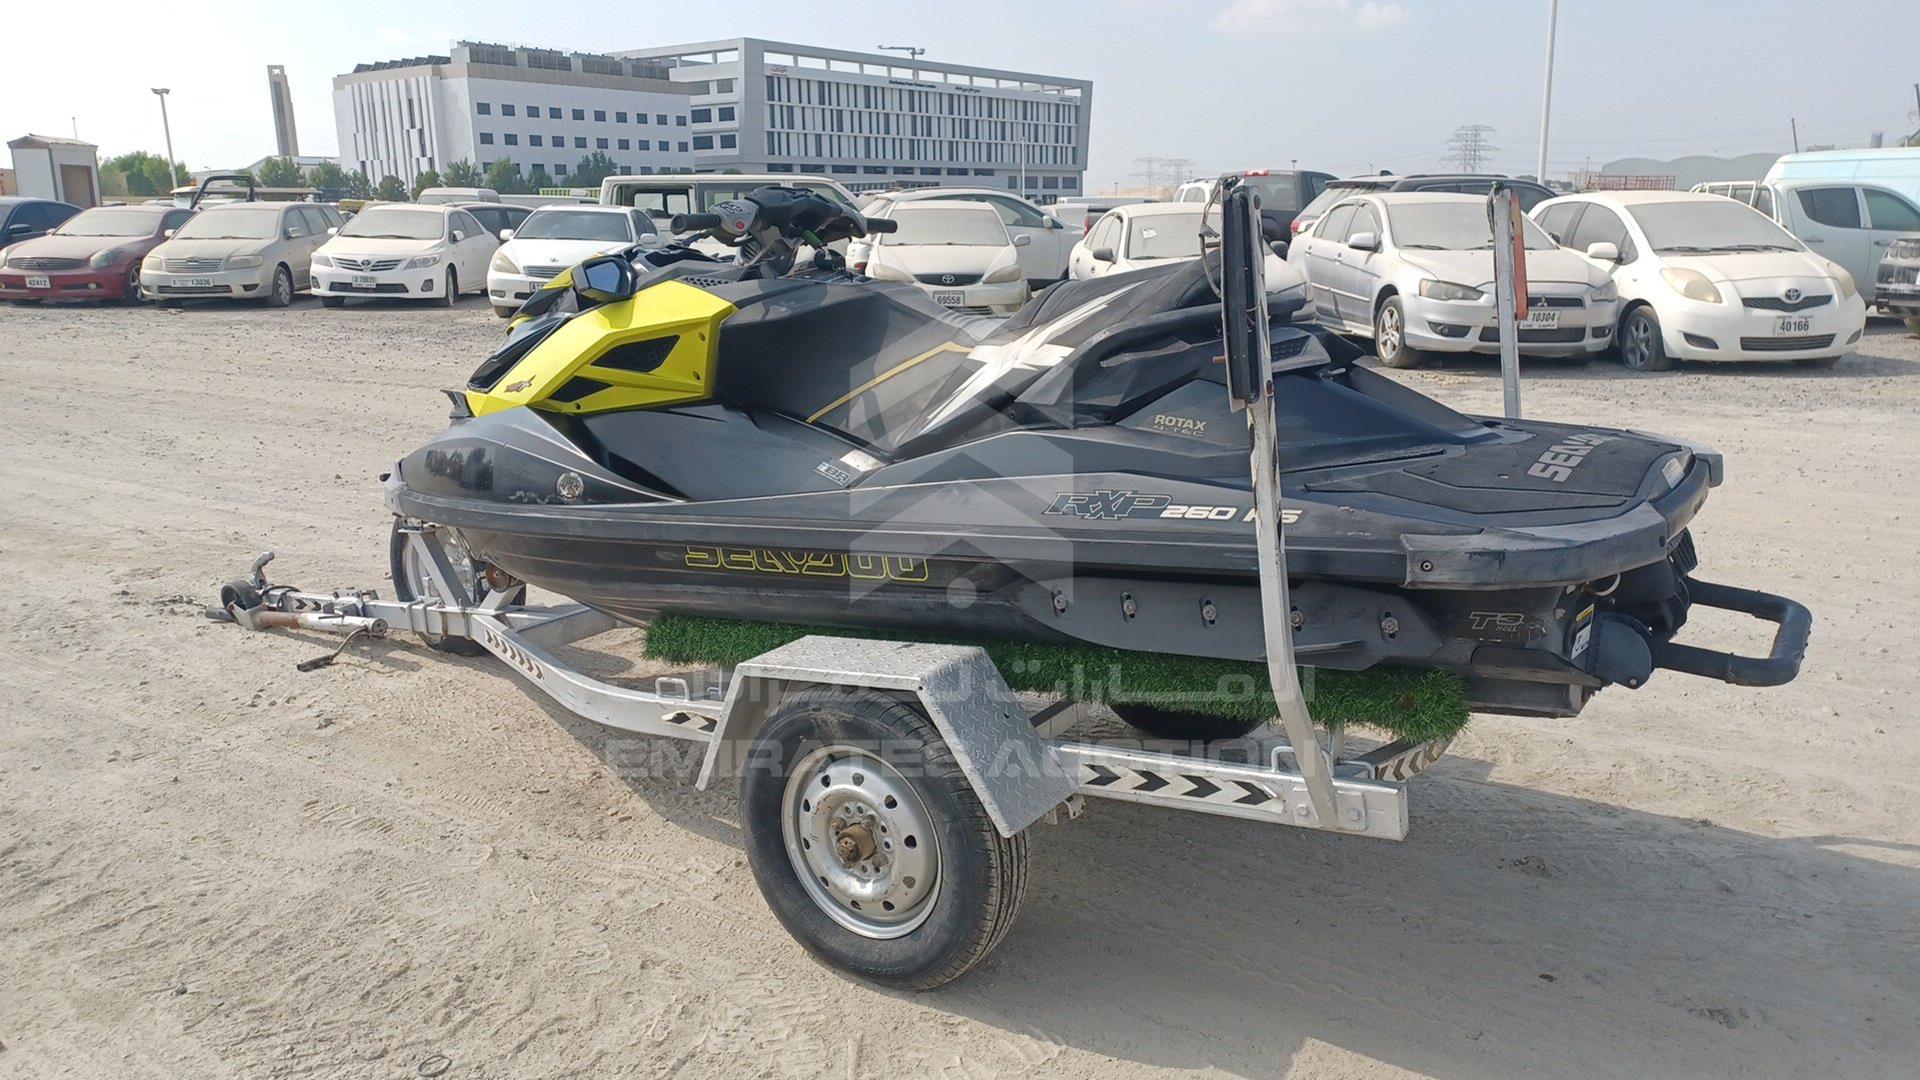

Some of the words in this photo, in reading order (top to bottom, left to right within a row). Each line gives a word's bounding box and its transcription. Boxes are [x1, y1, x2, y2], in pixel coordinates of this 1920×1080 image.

[936, 295, 961, 304] 69558
[1779, 320, 1809, 333] 40166
[1154, 414, 1206, 431] ROTAX
[1043, 489, 1173, 521] RXP
[1159, 504, 1239, 522] 260
[1470, 611, 1525, 630] T3
